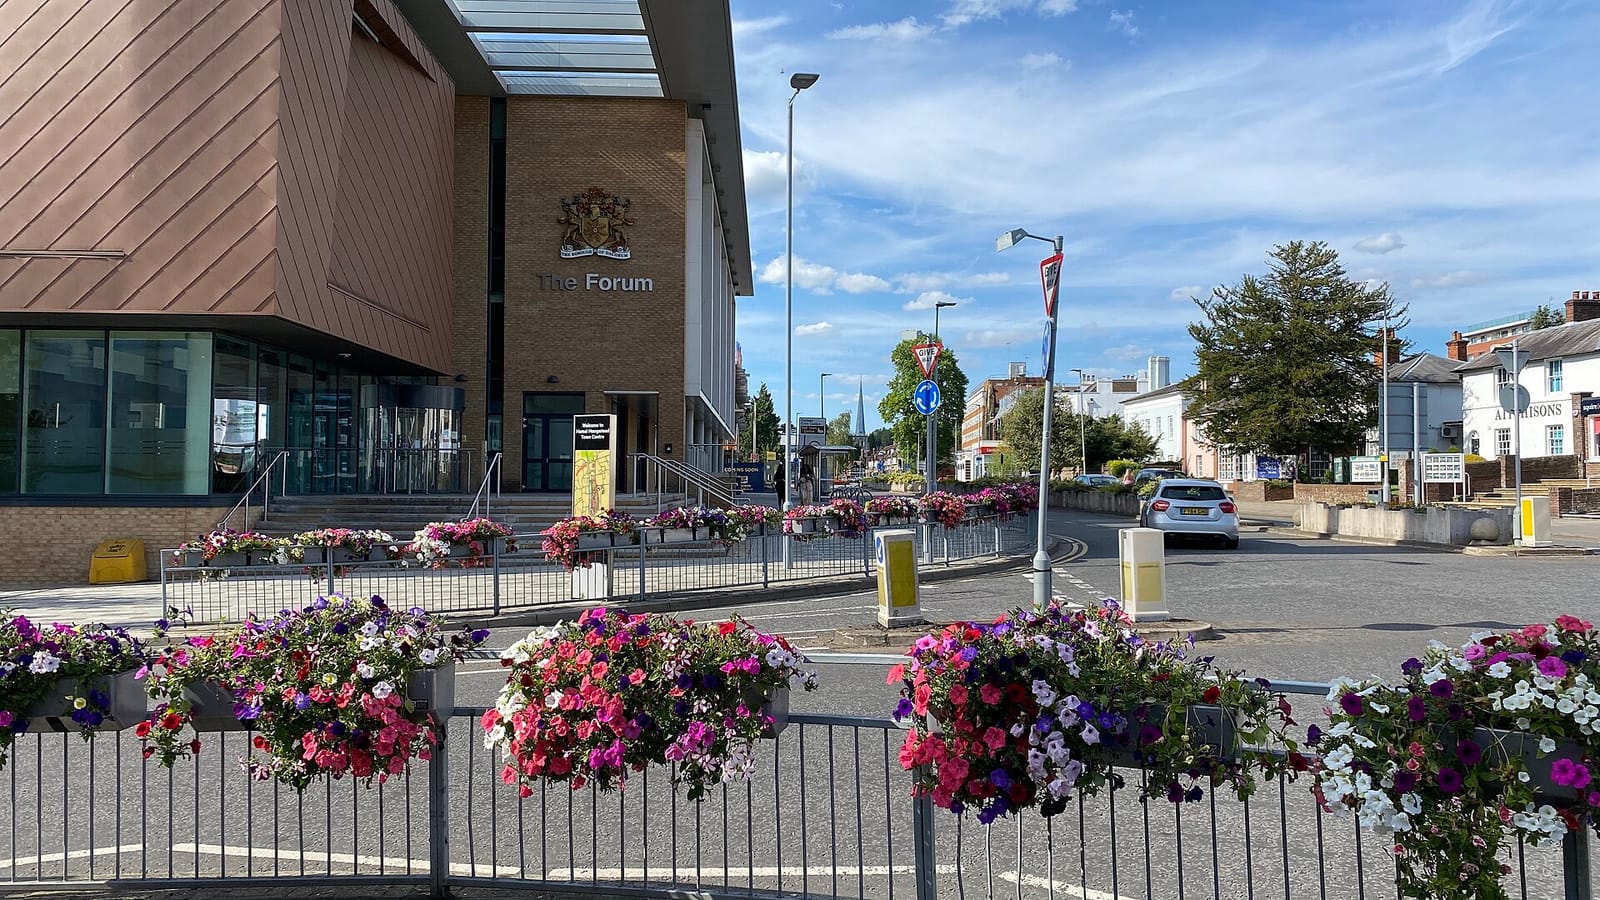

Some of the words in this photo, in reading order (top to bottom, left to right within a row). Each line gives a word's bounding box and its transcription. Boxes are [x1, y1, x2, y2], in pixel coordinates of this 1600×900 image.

[536, 273, 577, 291] The
[585, 273, 653, 291] Forum
[919, 348, 936, 357] GIVE
